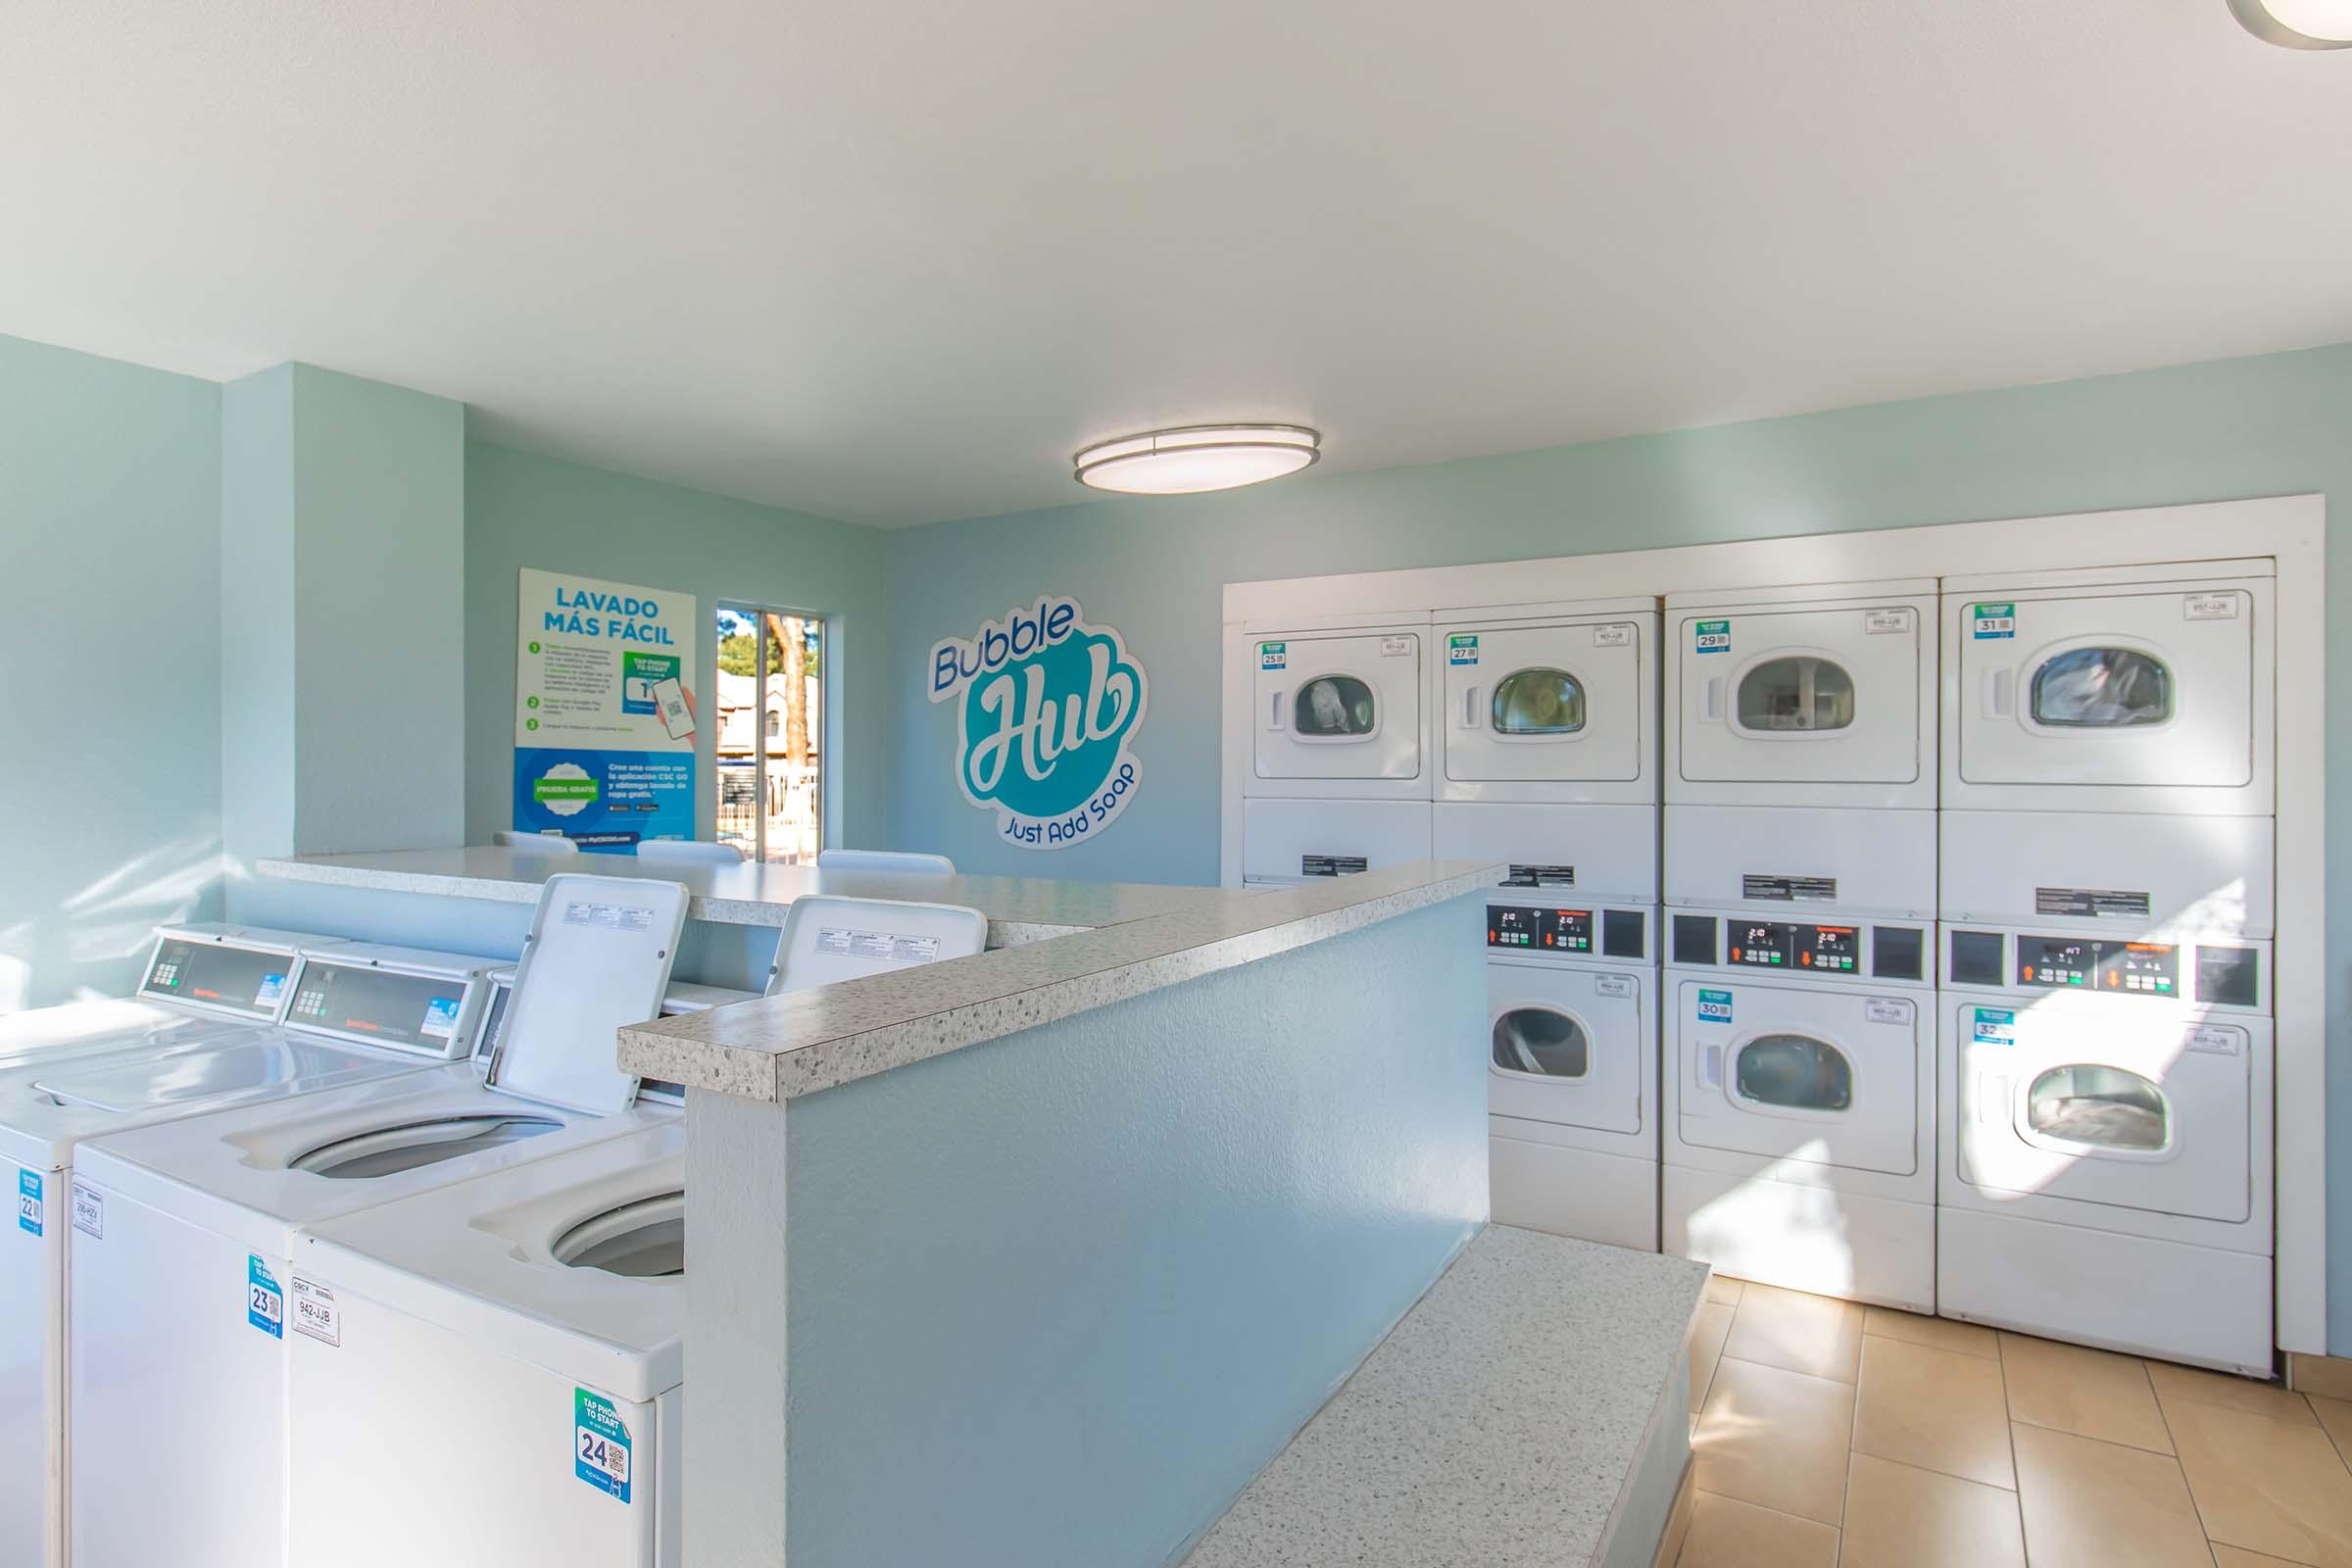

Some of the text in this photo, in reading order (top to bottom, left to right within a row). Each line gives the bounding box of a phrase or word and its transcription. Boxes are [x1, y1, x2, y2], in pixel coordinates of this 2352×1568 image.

[557, 587, 659, 618] LAVADO
[544, 611, 674, 645] MÁS FÁCIL
[1982, 619, 1996, 631] 31
[934, 603, 1075, 692] Bubble
[1700, 636, 1716, 647] 29
[1264, 655, 1276, 663] 25
[1454, 649, 1467, 659] 27
[969, 643, 1134, 792] Hub
[1005, 762, 1135, 844] Just Add Soap
[1702, 1004, 1718, 1014] 30
[1980, 1024, 1997, 1035] 32
[22, 1198, 33, 1217] 22
[253, 1288, 269, 1312] 23
[299, 1300, 330, 1323] 942-JJB
[583, 1397, 597, 1409] TAP
[586, 1408, 619, 1430] TO START
[581, 1433, 608, 1467] 24
